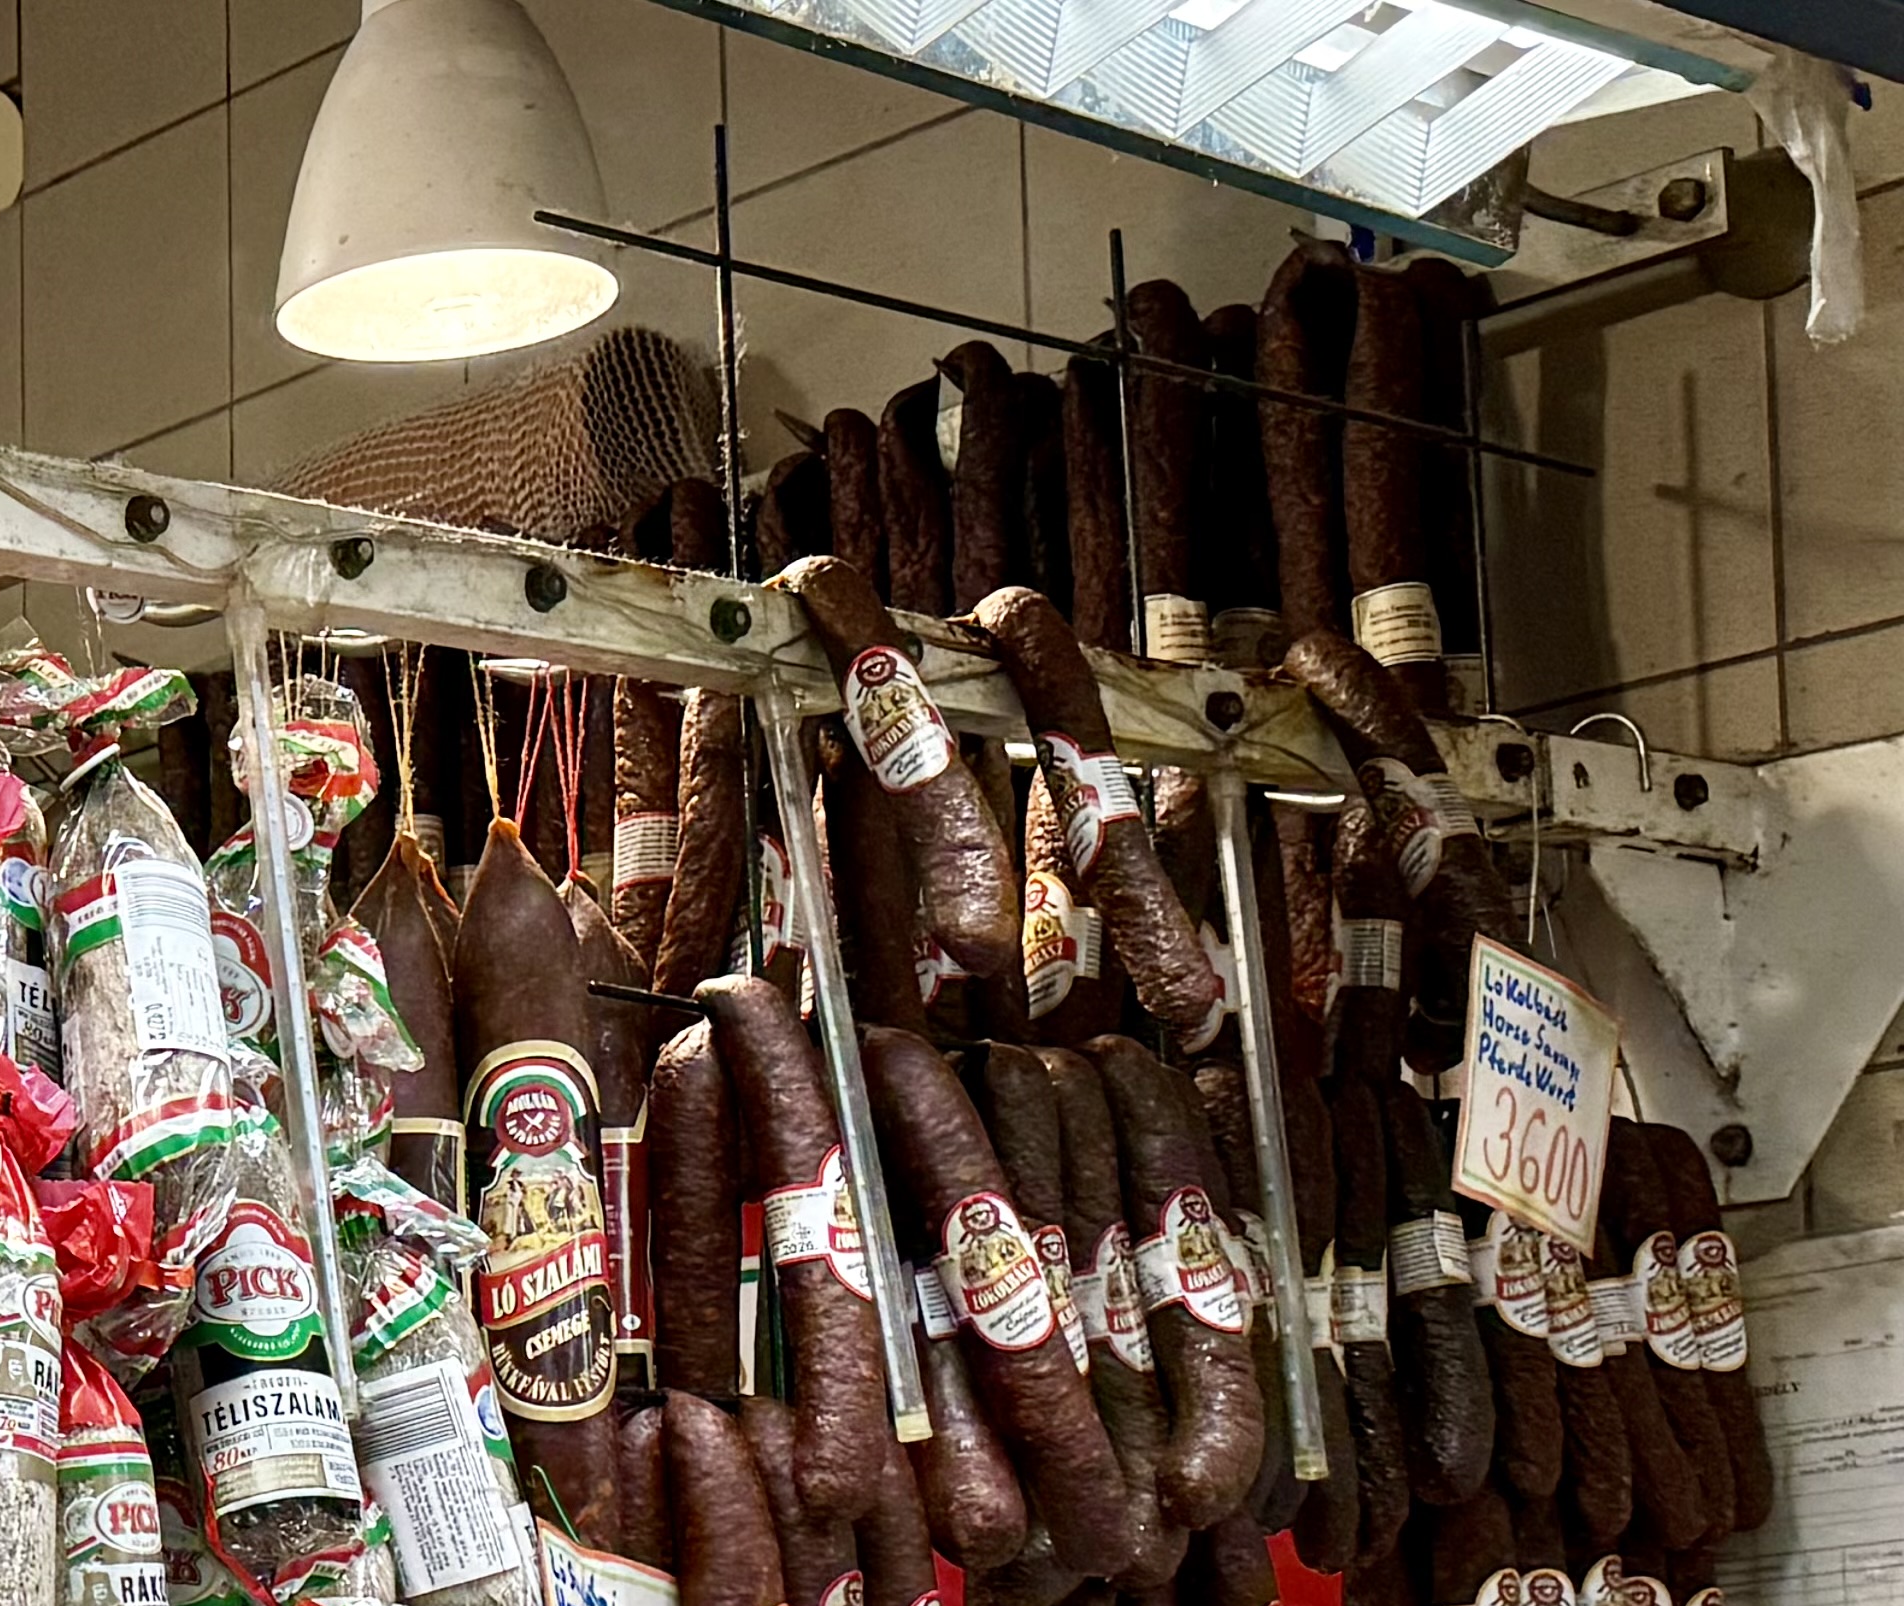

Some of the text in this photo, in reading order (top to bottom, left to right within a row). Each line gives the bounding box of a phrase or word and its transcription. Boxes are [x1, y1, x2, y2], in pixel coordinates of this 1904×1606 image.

[1482, 1086, 1589, 1221] 3600
[203, 1266, 303, 1308] PICK
[491, 1243, 604, 1320] LÓ SZALÁMI
[525, 1308, 592, 1361] CSEMEGE
[213, 1446, 240, 1472] 80
